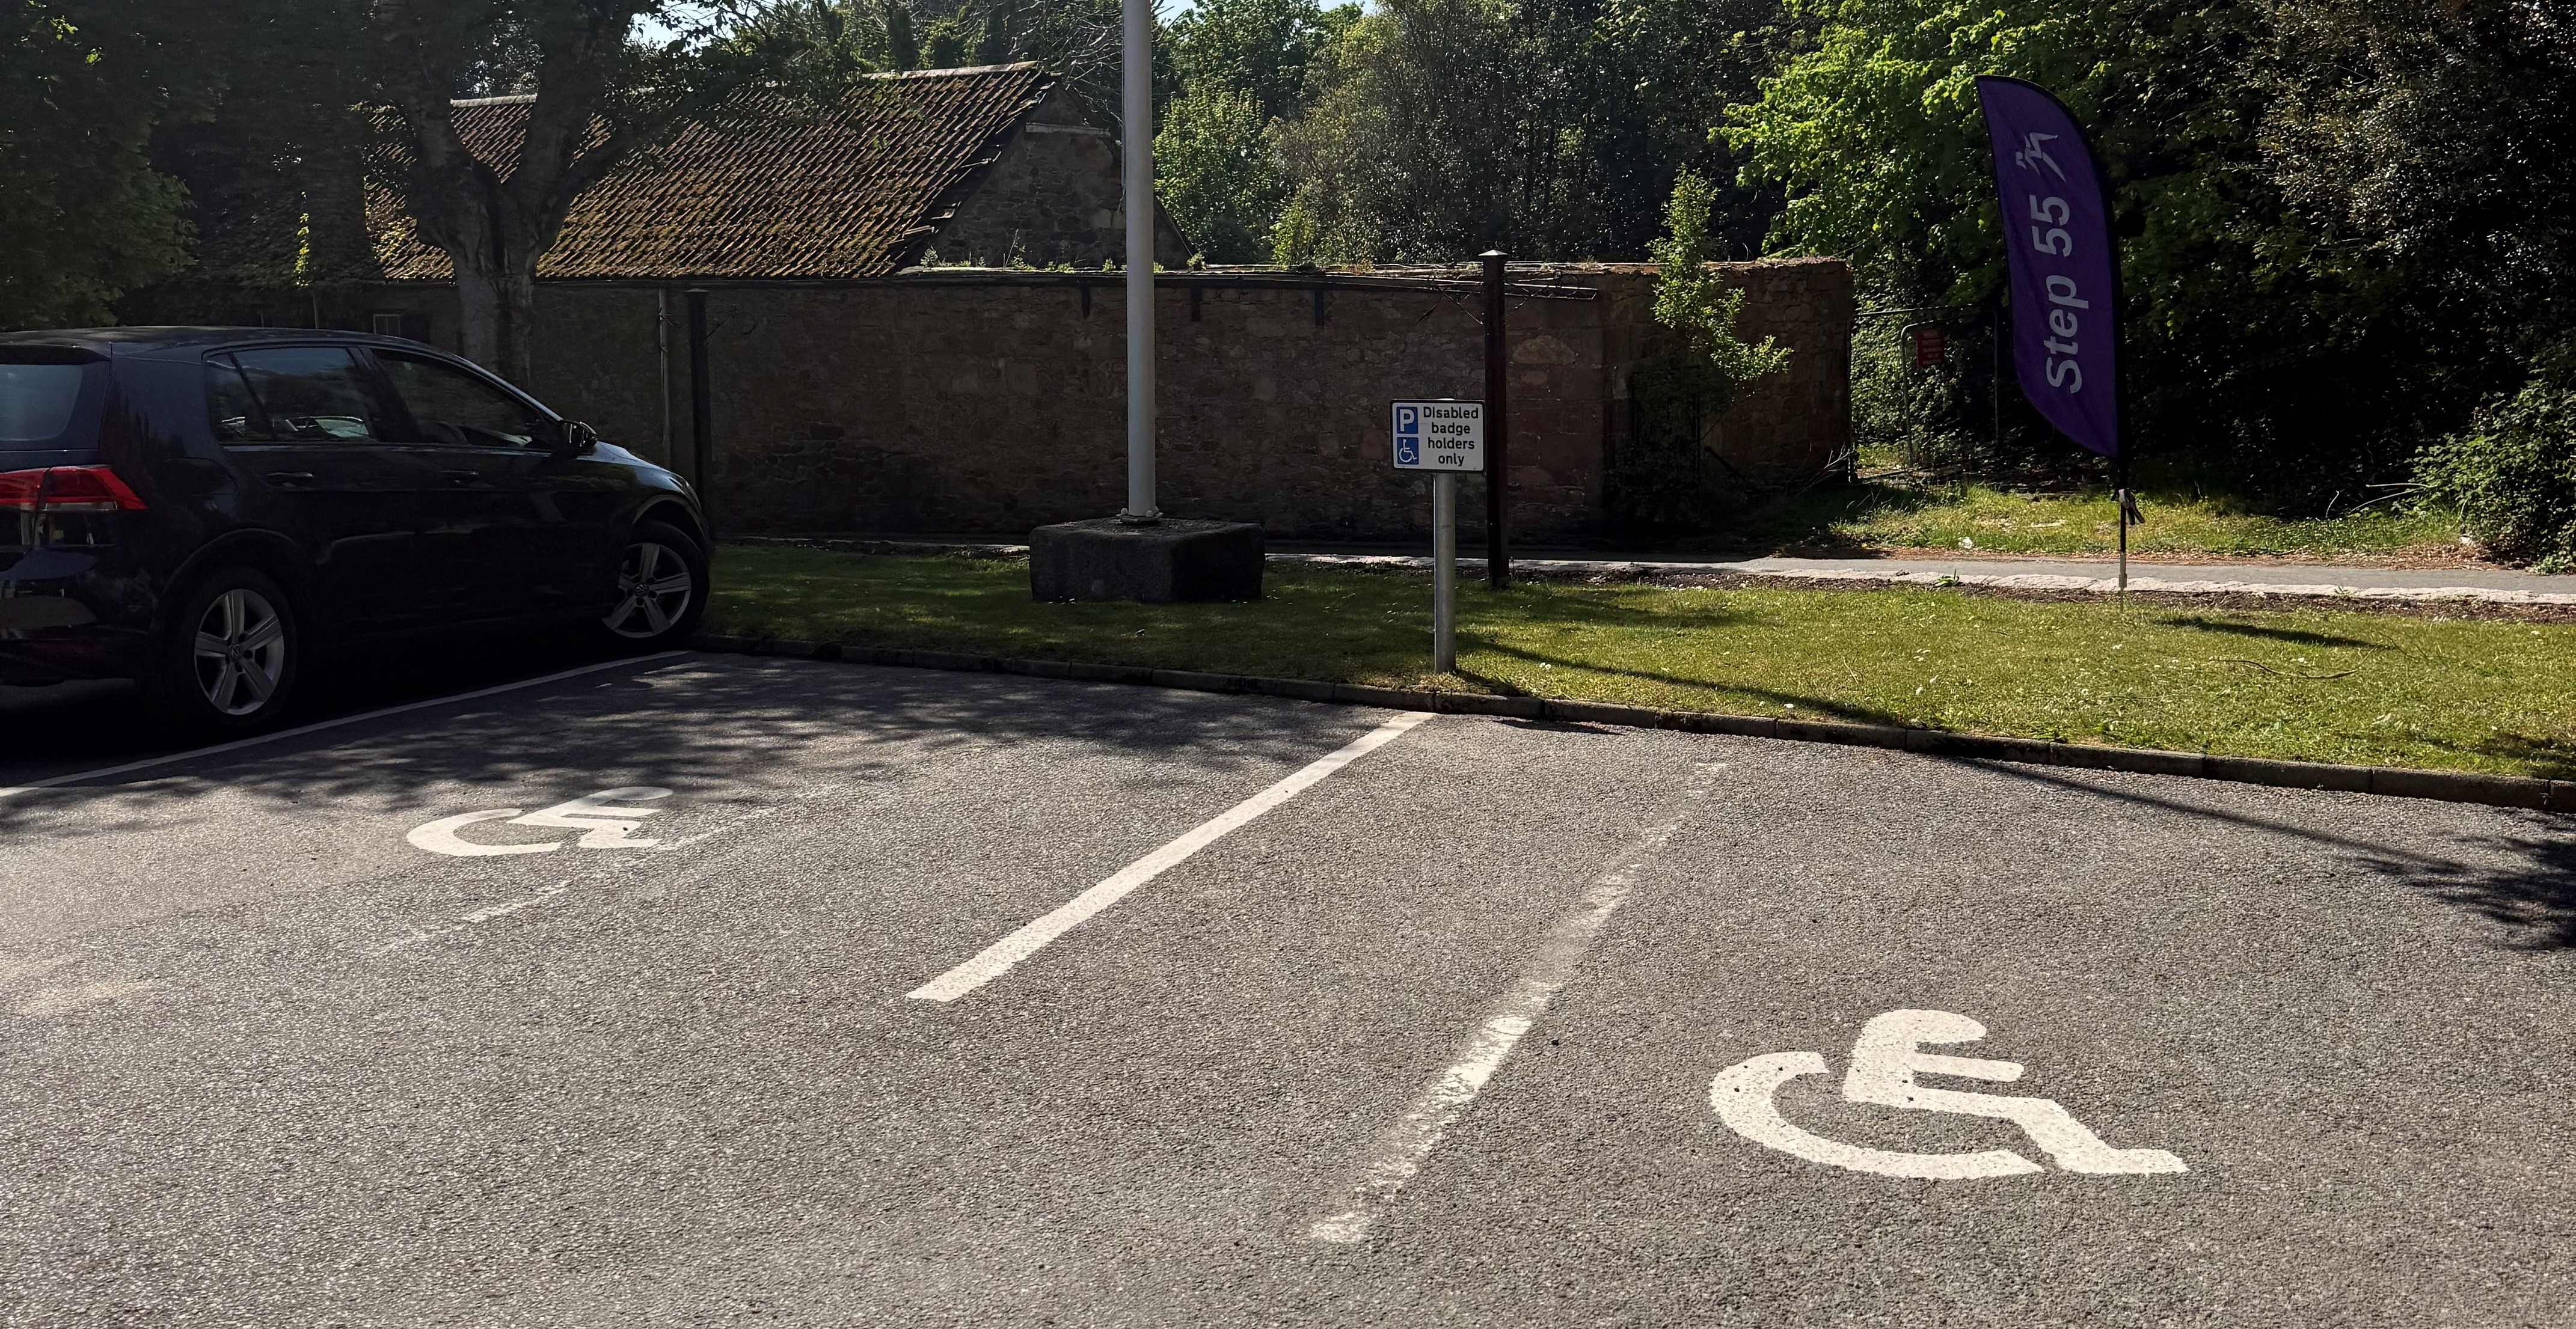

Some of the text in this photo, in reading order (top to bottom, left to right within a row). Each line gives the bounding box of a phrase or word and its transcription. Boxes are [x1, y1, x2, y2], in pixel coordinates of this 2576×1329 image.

[2029, 194, 2089, 394] Step 55
[1423, 406, 1479, 419] Disabled
[1399, 409, 1415, 432] P
[1432, 422, 1471, 436] badge
[1428, 436, 1475, 450] holders
[1438, 453, 1465, 466] only
